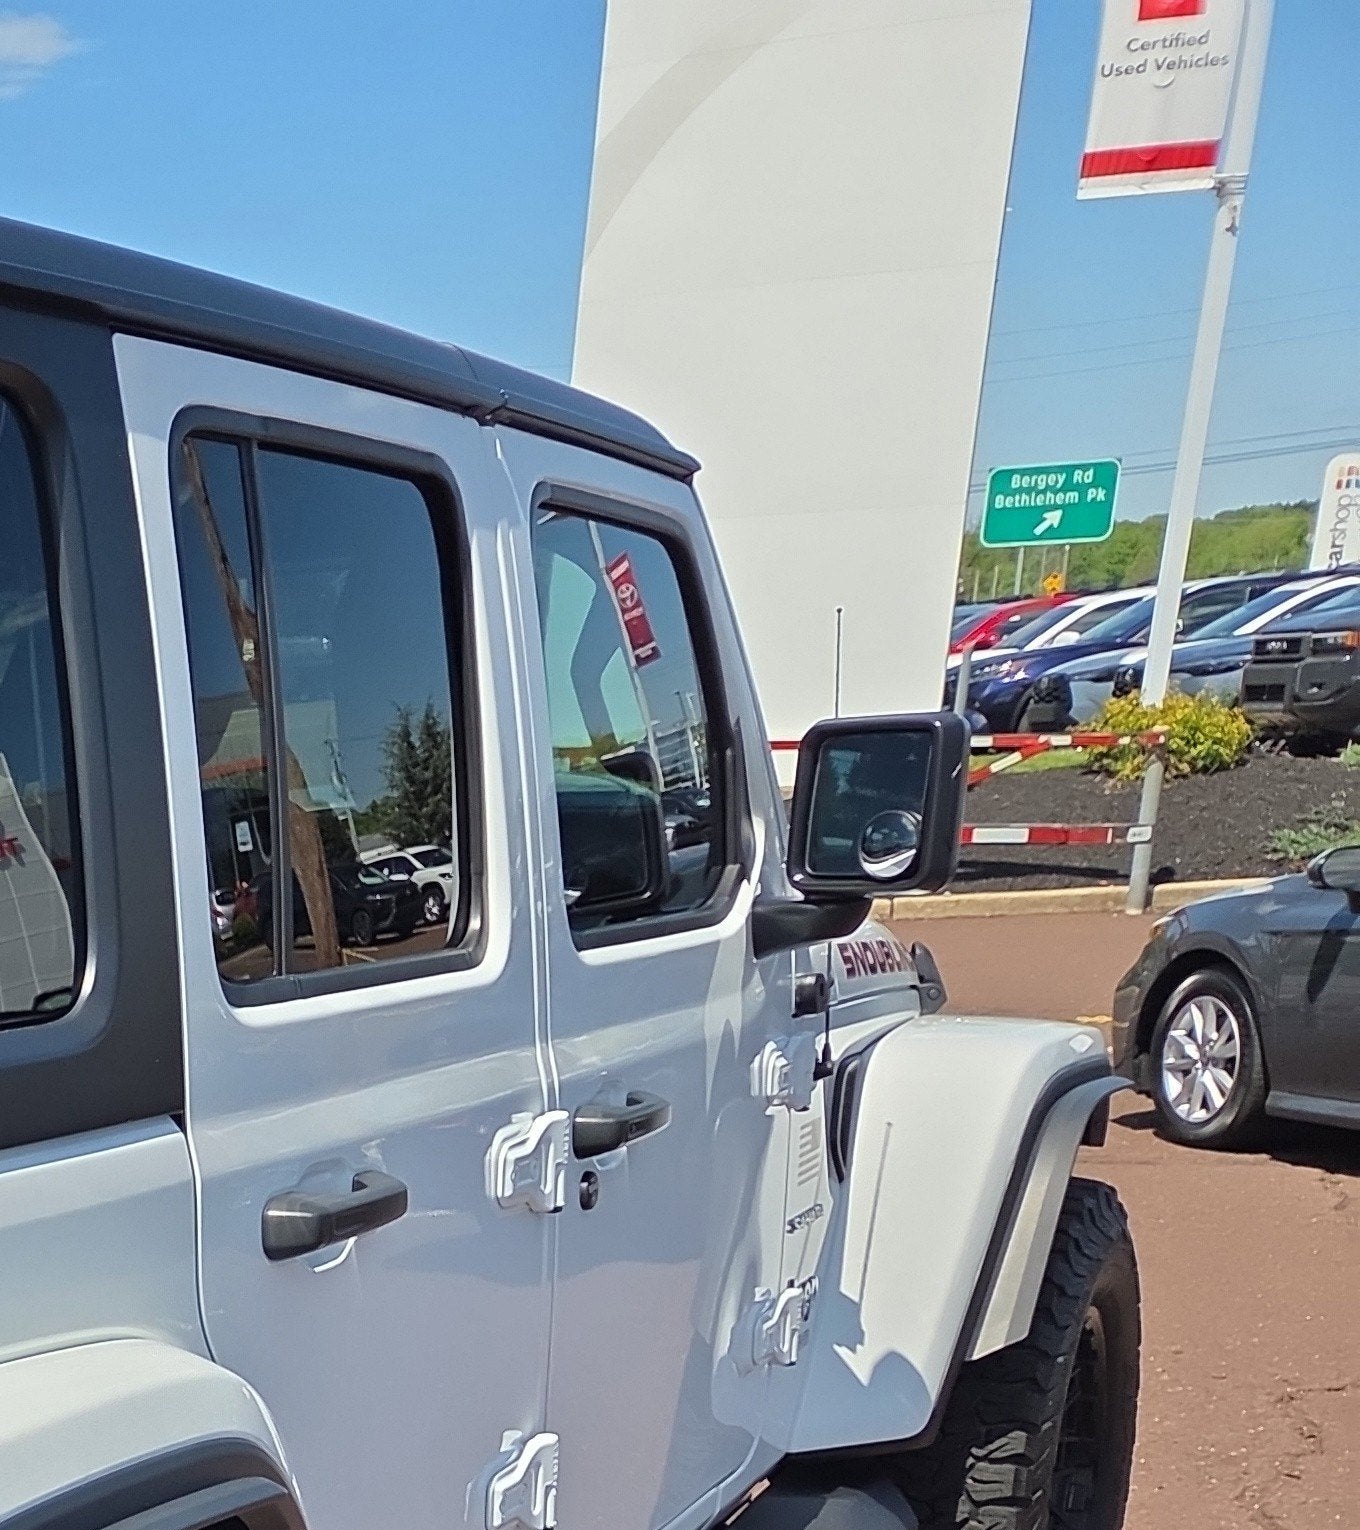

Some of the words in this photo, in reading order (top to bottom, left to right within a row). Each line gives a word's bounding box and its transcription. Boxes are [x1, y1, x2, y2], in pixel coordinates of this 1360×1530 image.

[1126, 29, 1210, 53] Certified
[1100, 57, 1147, 79] Used
[1153, 51, 1230, 73] Vehicles
[1011, 472, 1066, 490] Bergey
[1073, 468, 1094, 484] Rd
[994, 490, 1079, 509] Bethlehem
[1087, 486, 1107, 503] Pk
